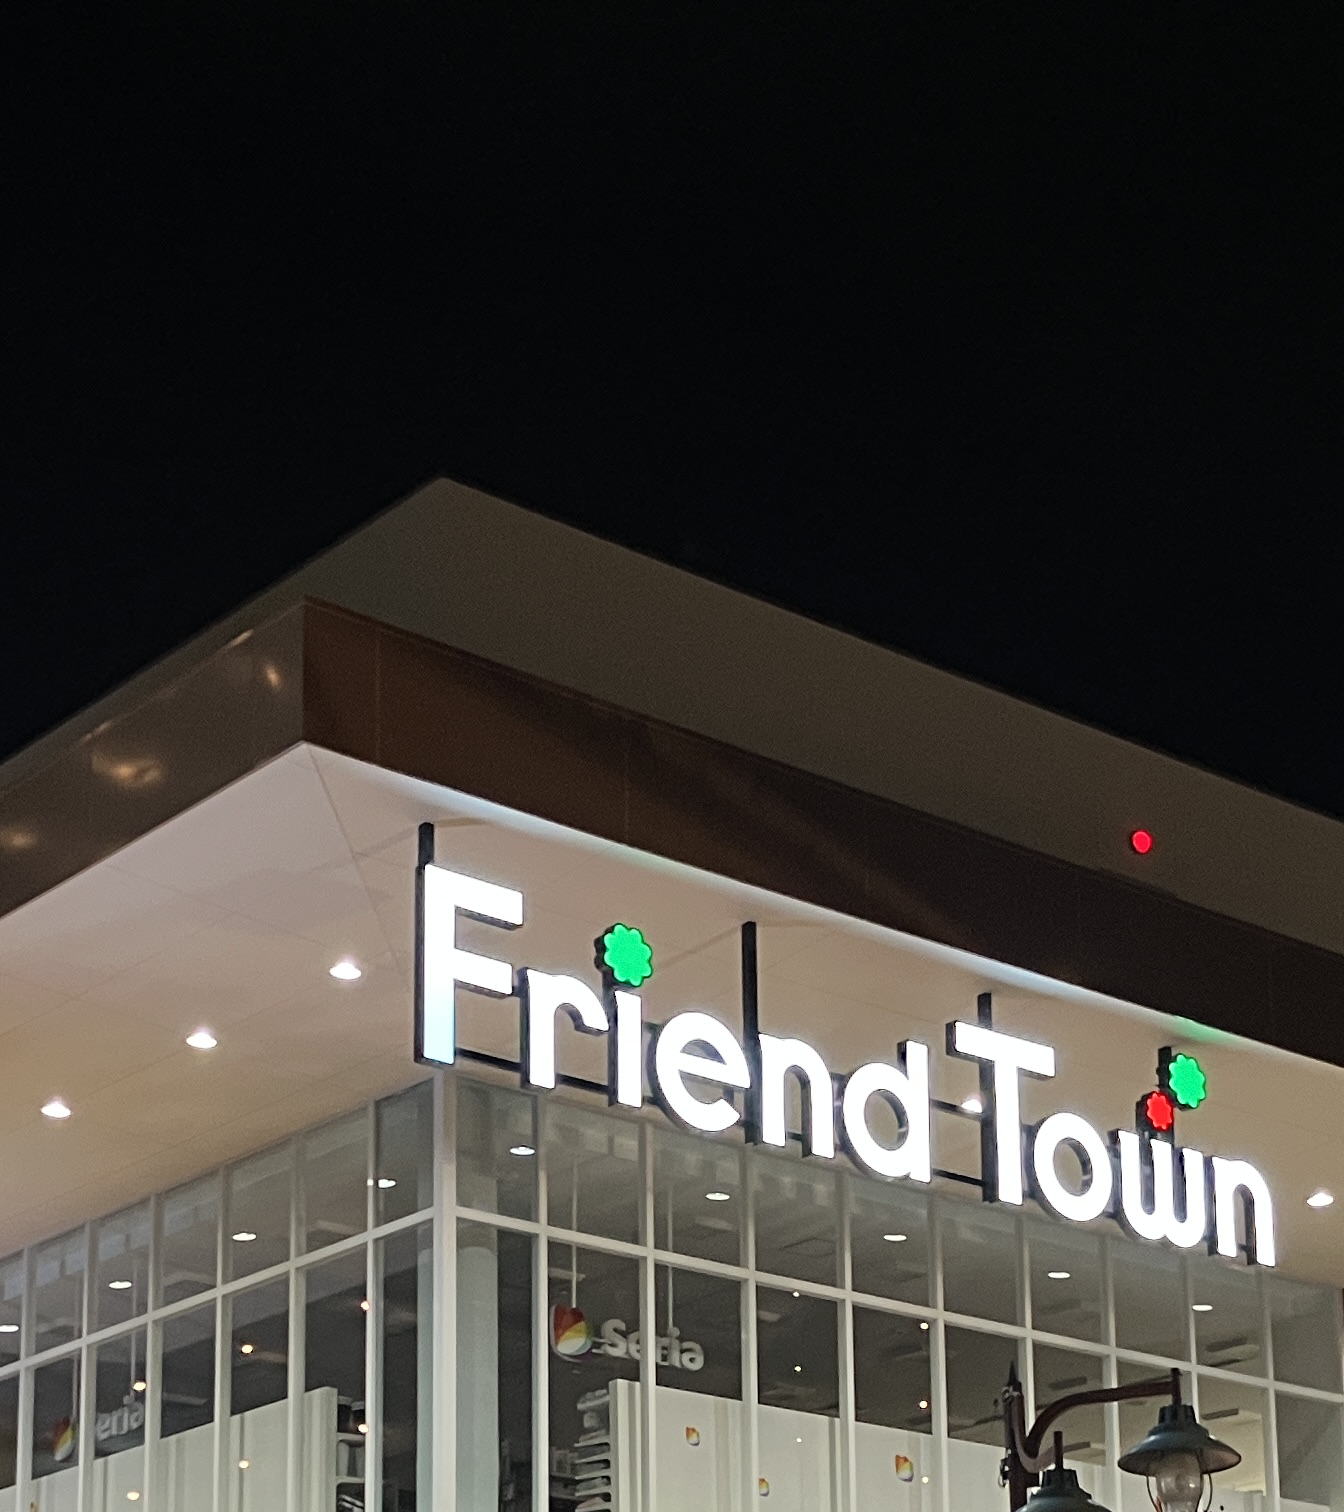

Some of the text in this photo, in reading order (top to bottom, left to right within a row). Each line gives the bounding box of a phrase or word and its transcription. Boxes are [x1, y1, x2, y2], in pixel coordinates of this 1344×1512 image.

[418, 862, 1276, 1268] Friend Town
[95, 1394, 145, 1441] eria
